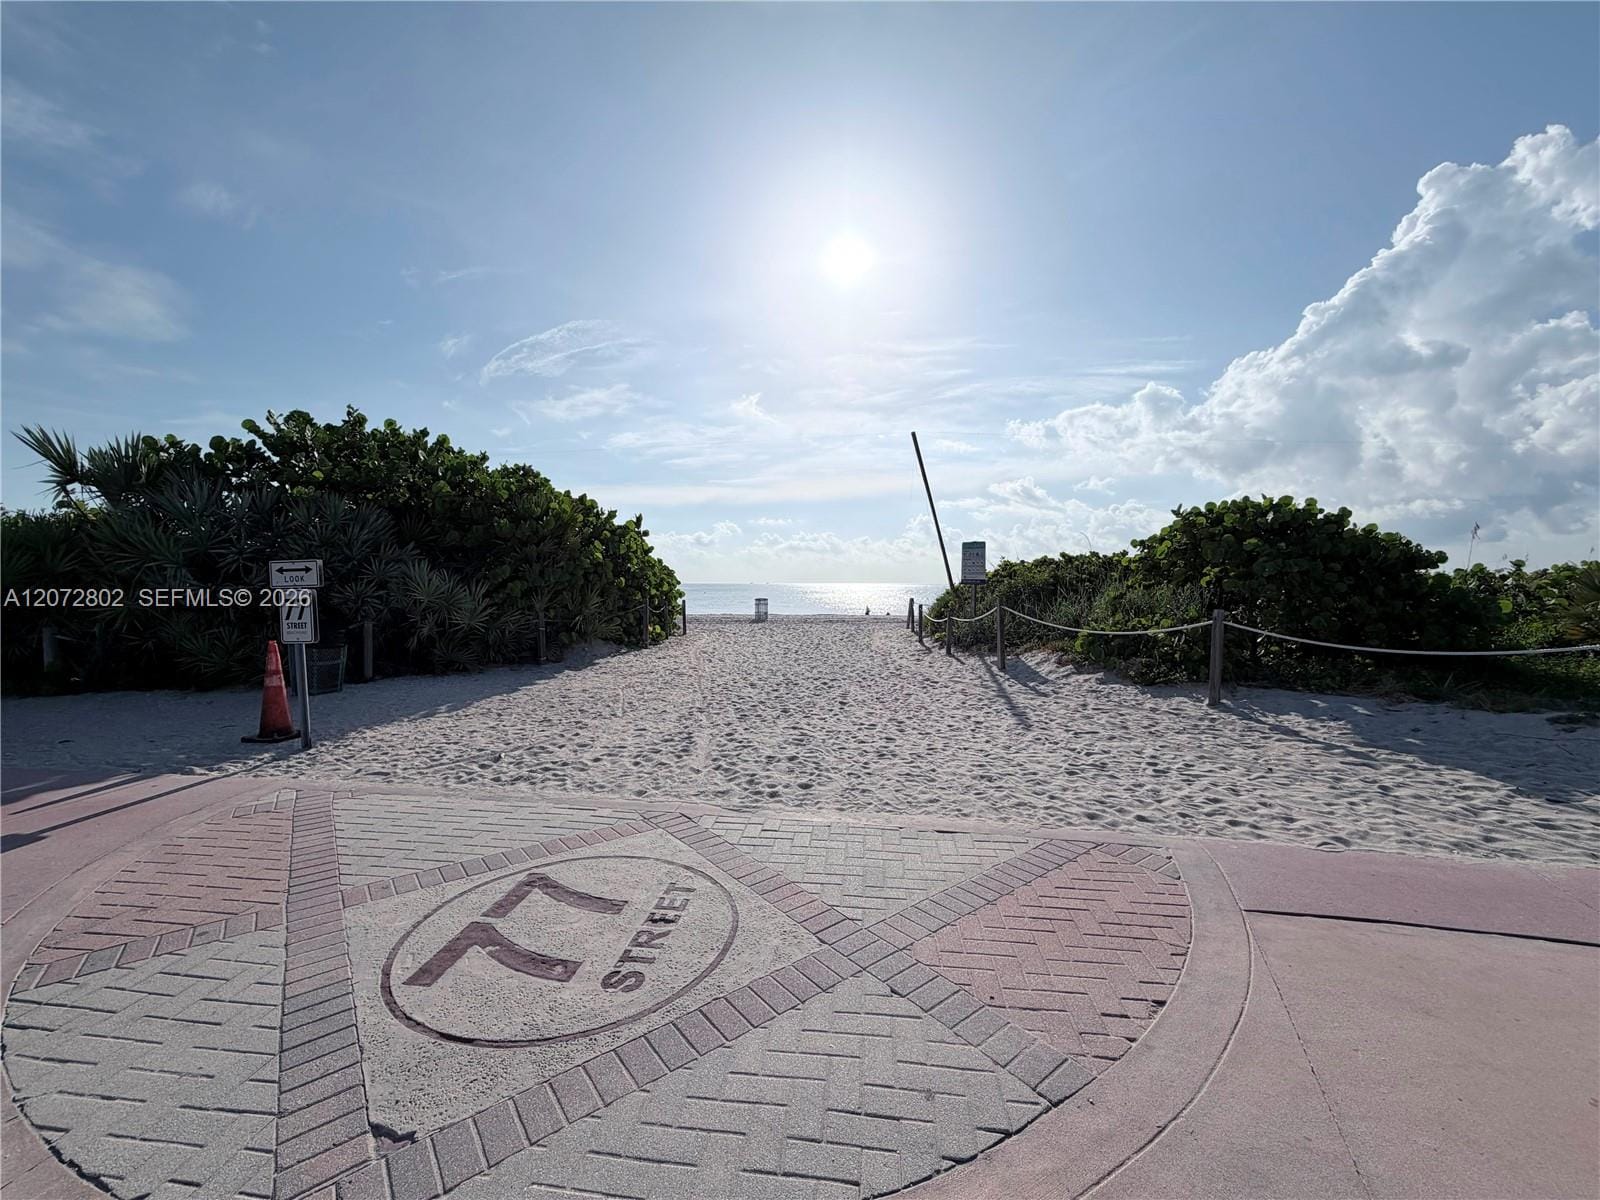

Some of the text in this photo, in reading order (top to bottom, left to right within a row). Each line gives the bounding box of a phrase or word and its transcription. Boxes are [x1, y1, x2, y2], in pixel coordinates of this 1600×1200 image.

[286, 622, 308, 630] STREET
[402, 872, 628, 987] 77
[600, 882, 697, 993] STREET
